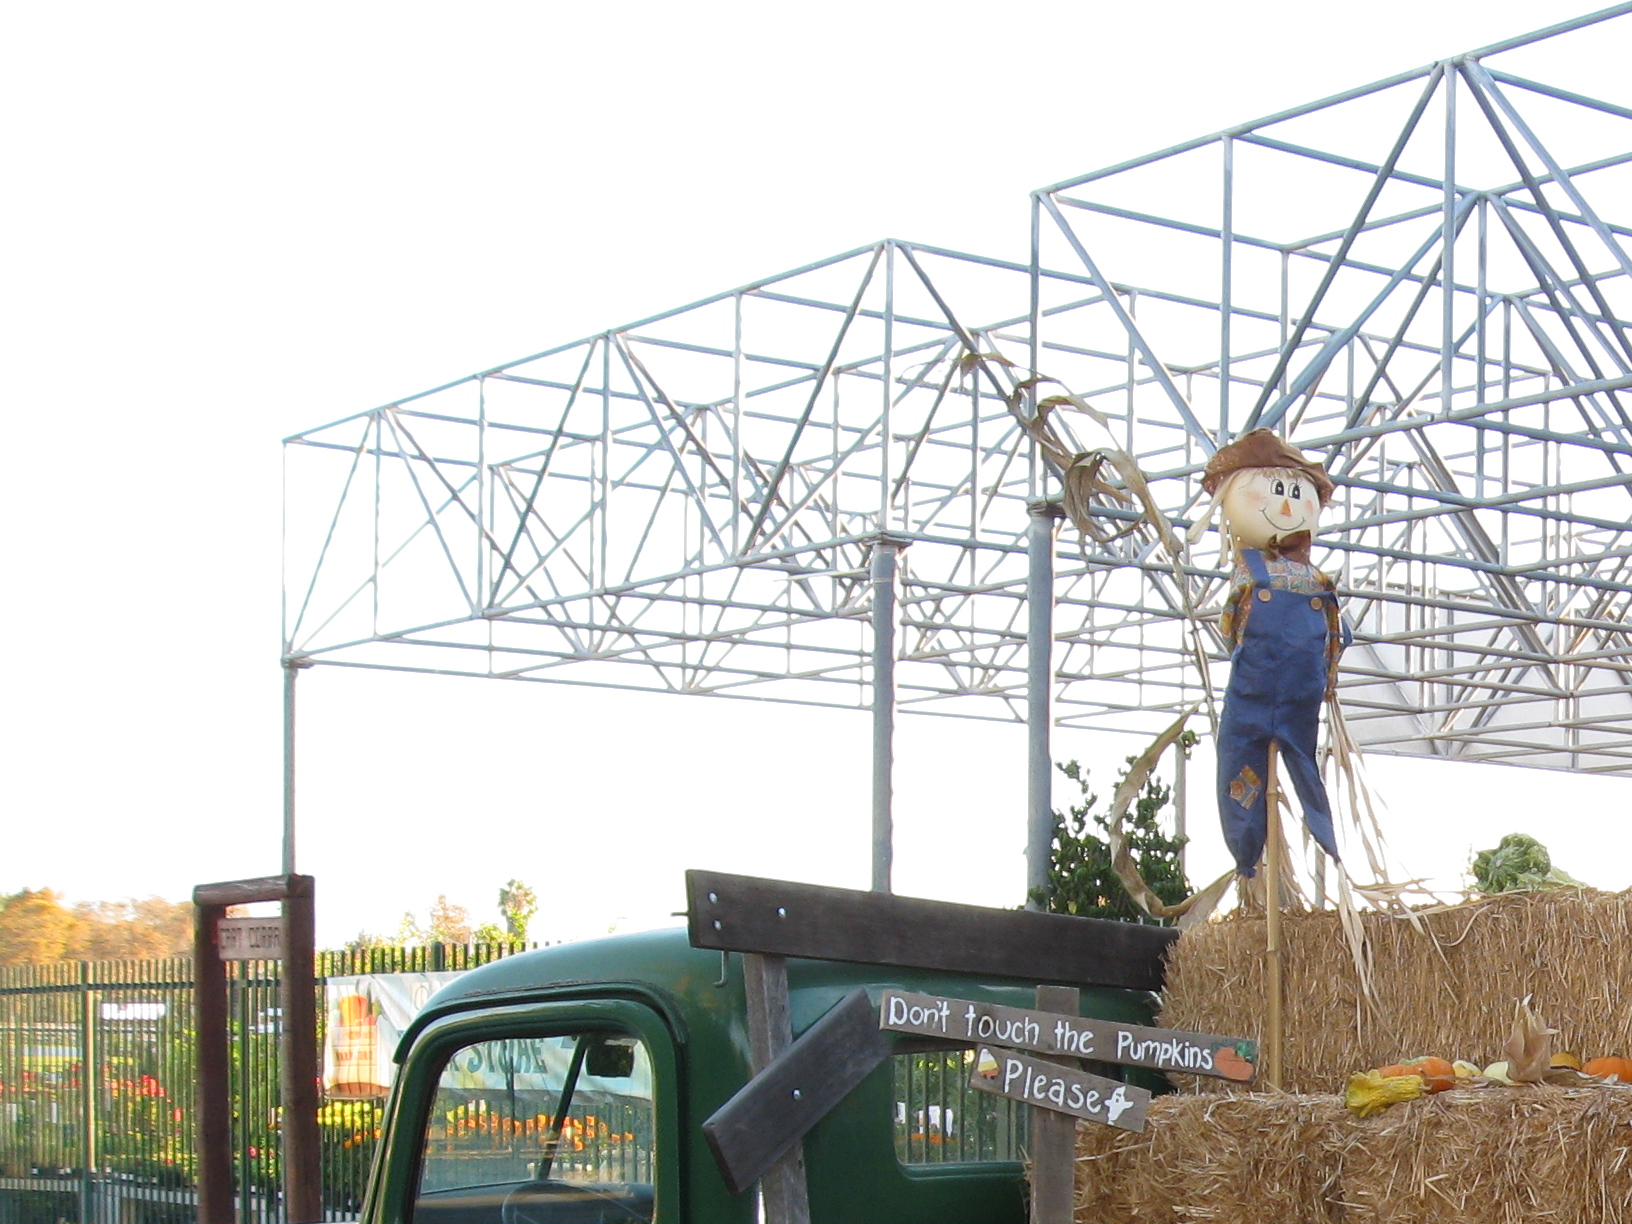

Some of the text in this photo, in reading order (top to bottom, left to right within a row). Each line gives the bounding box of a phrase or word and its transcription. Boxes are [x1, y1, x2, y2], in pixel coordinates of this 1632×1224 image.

[888, 996, 1214, 1071] Don't touch the Pumpkins
[1003, 1059, 1102, 1114] Please
